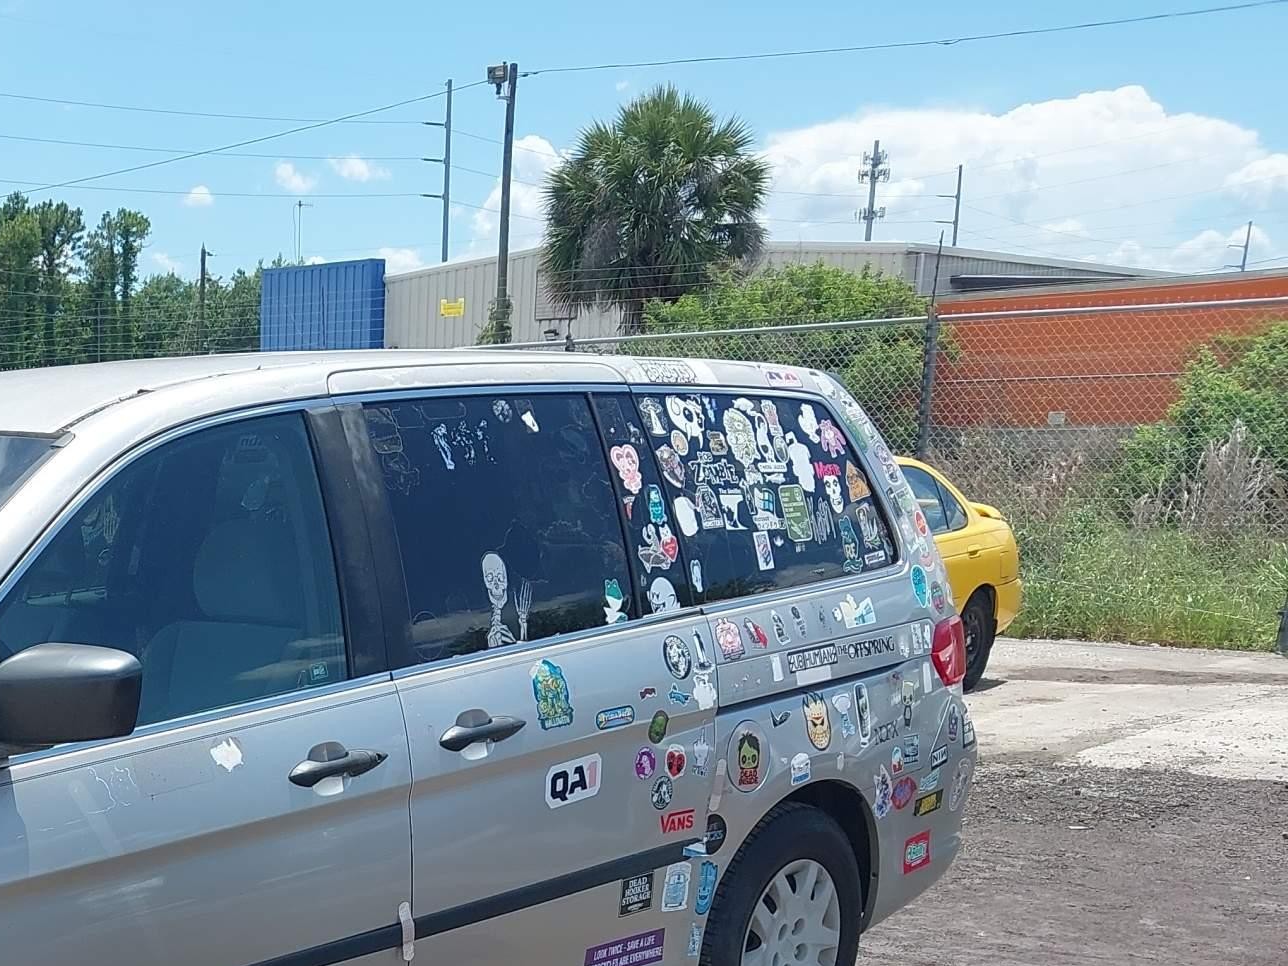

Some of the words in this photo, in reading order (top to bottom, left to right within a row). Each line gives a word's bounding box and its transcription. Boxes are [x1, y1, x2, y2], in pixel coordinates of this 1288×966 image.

[848, 636, 895, 659] OFFSPRING
[550, 761, 598, 801] QA1
[740, 769, 758, 778] DEAD
[660, 809, 696, 834] VANS
[625, 884, 650, 898] HOOKER
[629, 876, 648, 888] DEAD
[621, 891, 652, 906] STORAGE
[593, 948, 609, 961] LOOK
[608, 944, 624, 957] TWICE
[626, 939, 640, 951] SAVE
[644, 935, 656, 946] LIFE
[618, 956, 630, 966] ARE
[629, 946, 664, 964] EVERYWHERE
